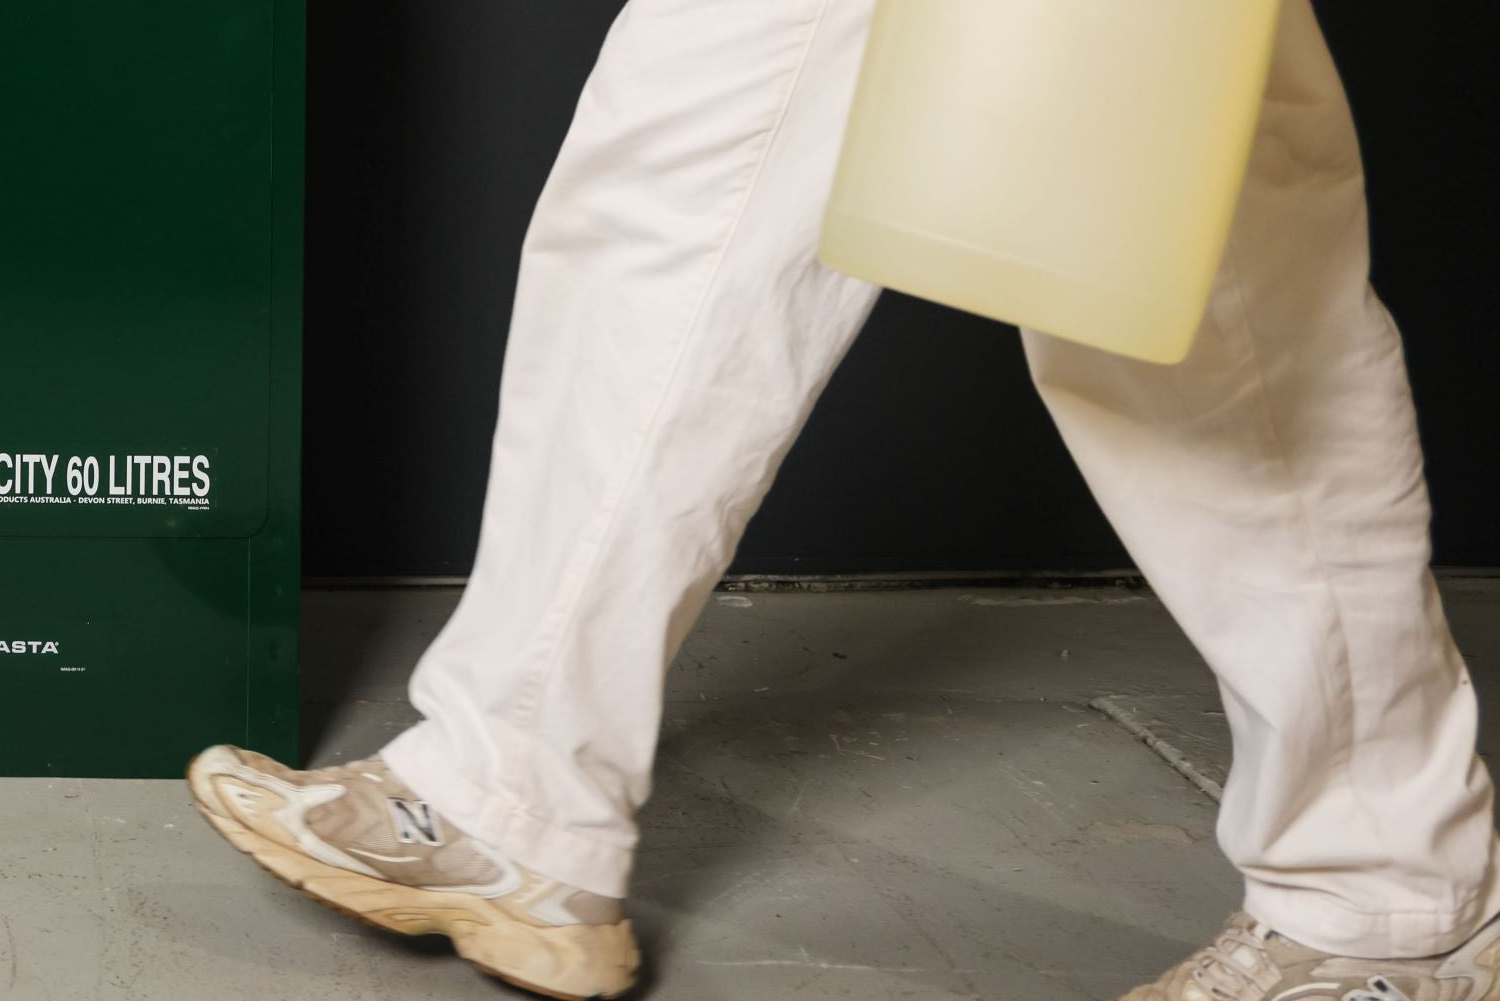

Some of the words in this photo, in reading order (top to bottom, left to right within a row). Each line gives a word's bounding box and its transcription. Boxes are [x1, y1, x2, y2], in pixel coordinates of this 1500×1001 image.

[66, 456, 99, 496] 60
[109, 455, 210, 496] LITRES
[30, 496, 71, 504] AUSTRALIA
[107, 497, 135, 505] STREET,
[137, 497, 167, 505] BURNIE,
[169, 497, 210, 505] TASMANIA
